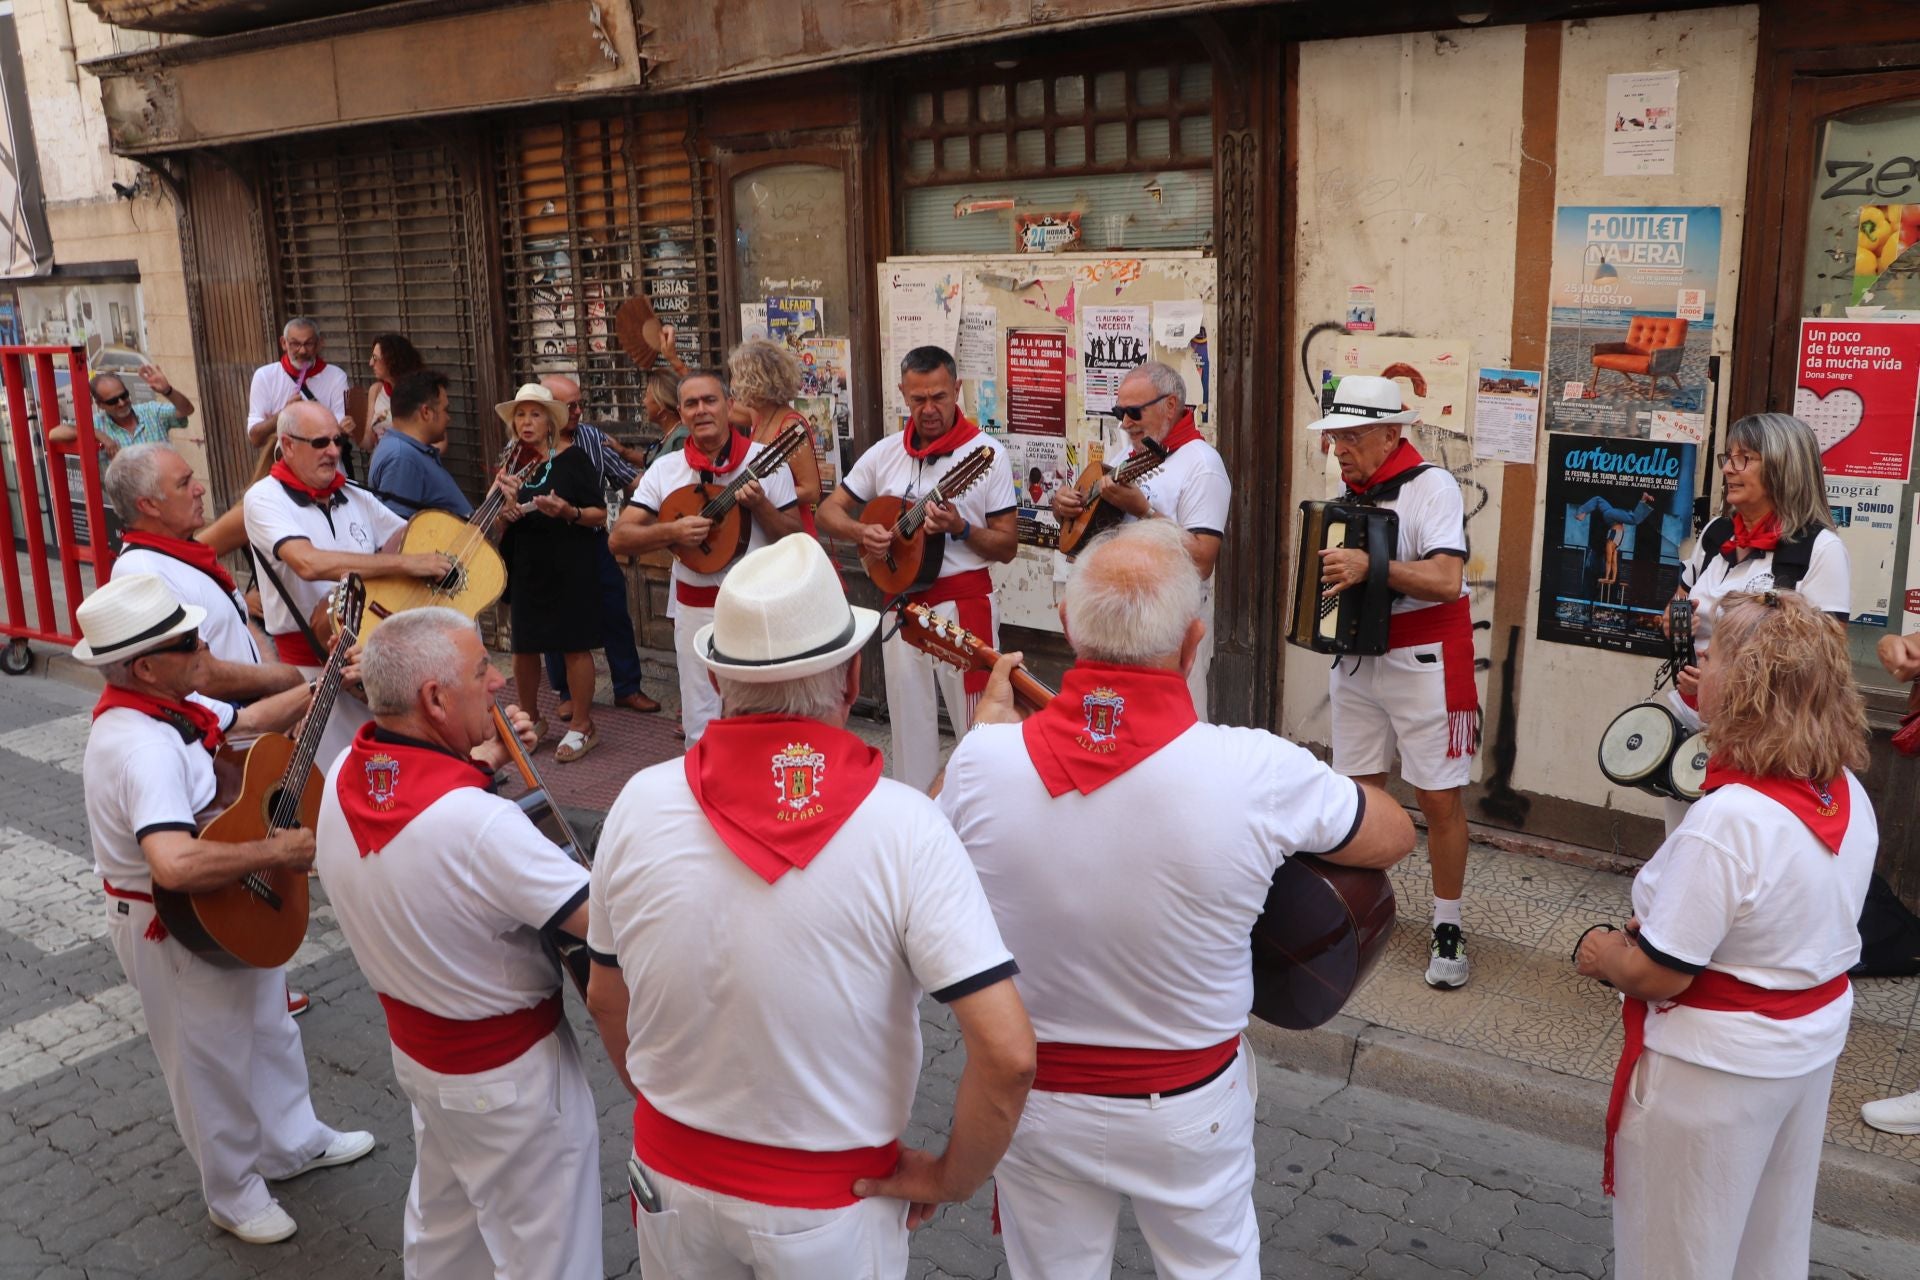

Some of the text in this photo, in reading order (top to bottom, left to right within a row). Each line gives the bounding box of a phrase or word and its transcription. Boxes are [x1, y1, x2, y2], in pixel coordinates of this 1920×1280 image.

[1031, 228, 1046, 250] 24
[651, 279, 688, 293] FIESTAS
[1578, 284, 1612, 294] JULIO
[653, 297, 689, 311] ALFARO
[1582, 294, 1633, 305] AGOSTO
[1809, 330, 1861, 343] Un poco
[1035, 339, 1053, 348] PLANTA
[1808, 343, 1890, 356] de tu verano
[1041, 349, 1062, 358] CERVERA
[1011, 358, 1019, 366] DEL
[1806, 356, 1902, 370] da mucha vida
[1805, 371, 1853, 381] Dona Sangre
[1340, 406, 1367, 415] SAMSUNG
[1565, 446, 1680, 478] artencalle
[1824, 484, 1881, 498] onograf
[1857, 502, 1894, 514] SONIDO
[1872, 521, 1892, 529] DIRECTO
[1075, 735, 1116, 753] ALFARO
[777, 804, 824, 822] ALFARO
